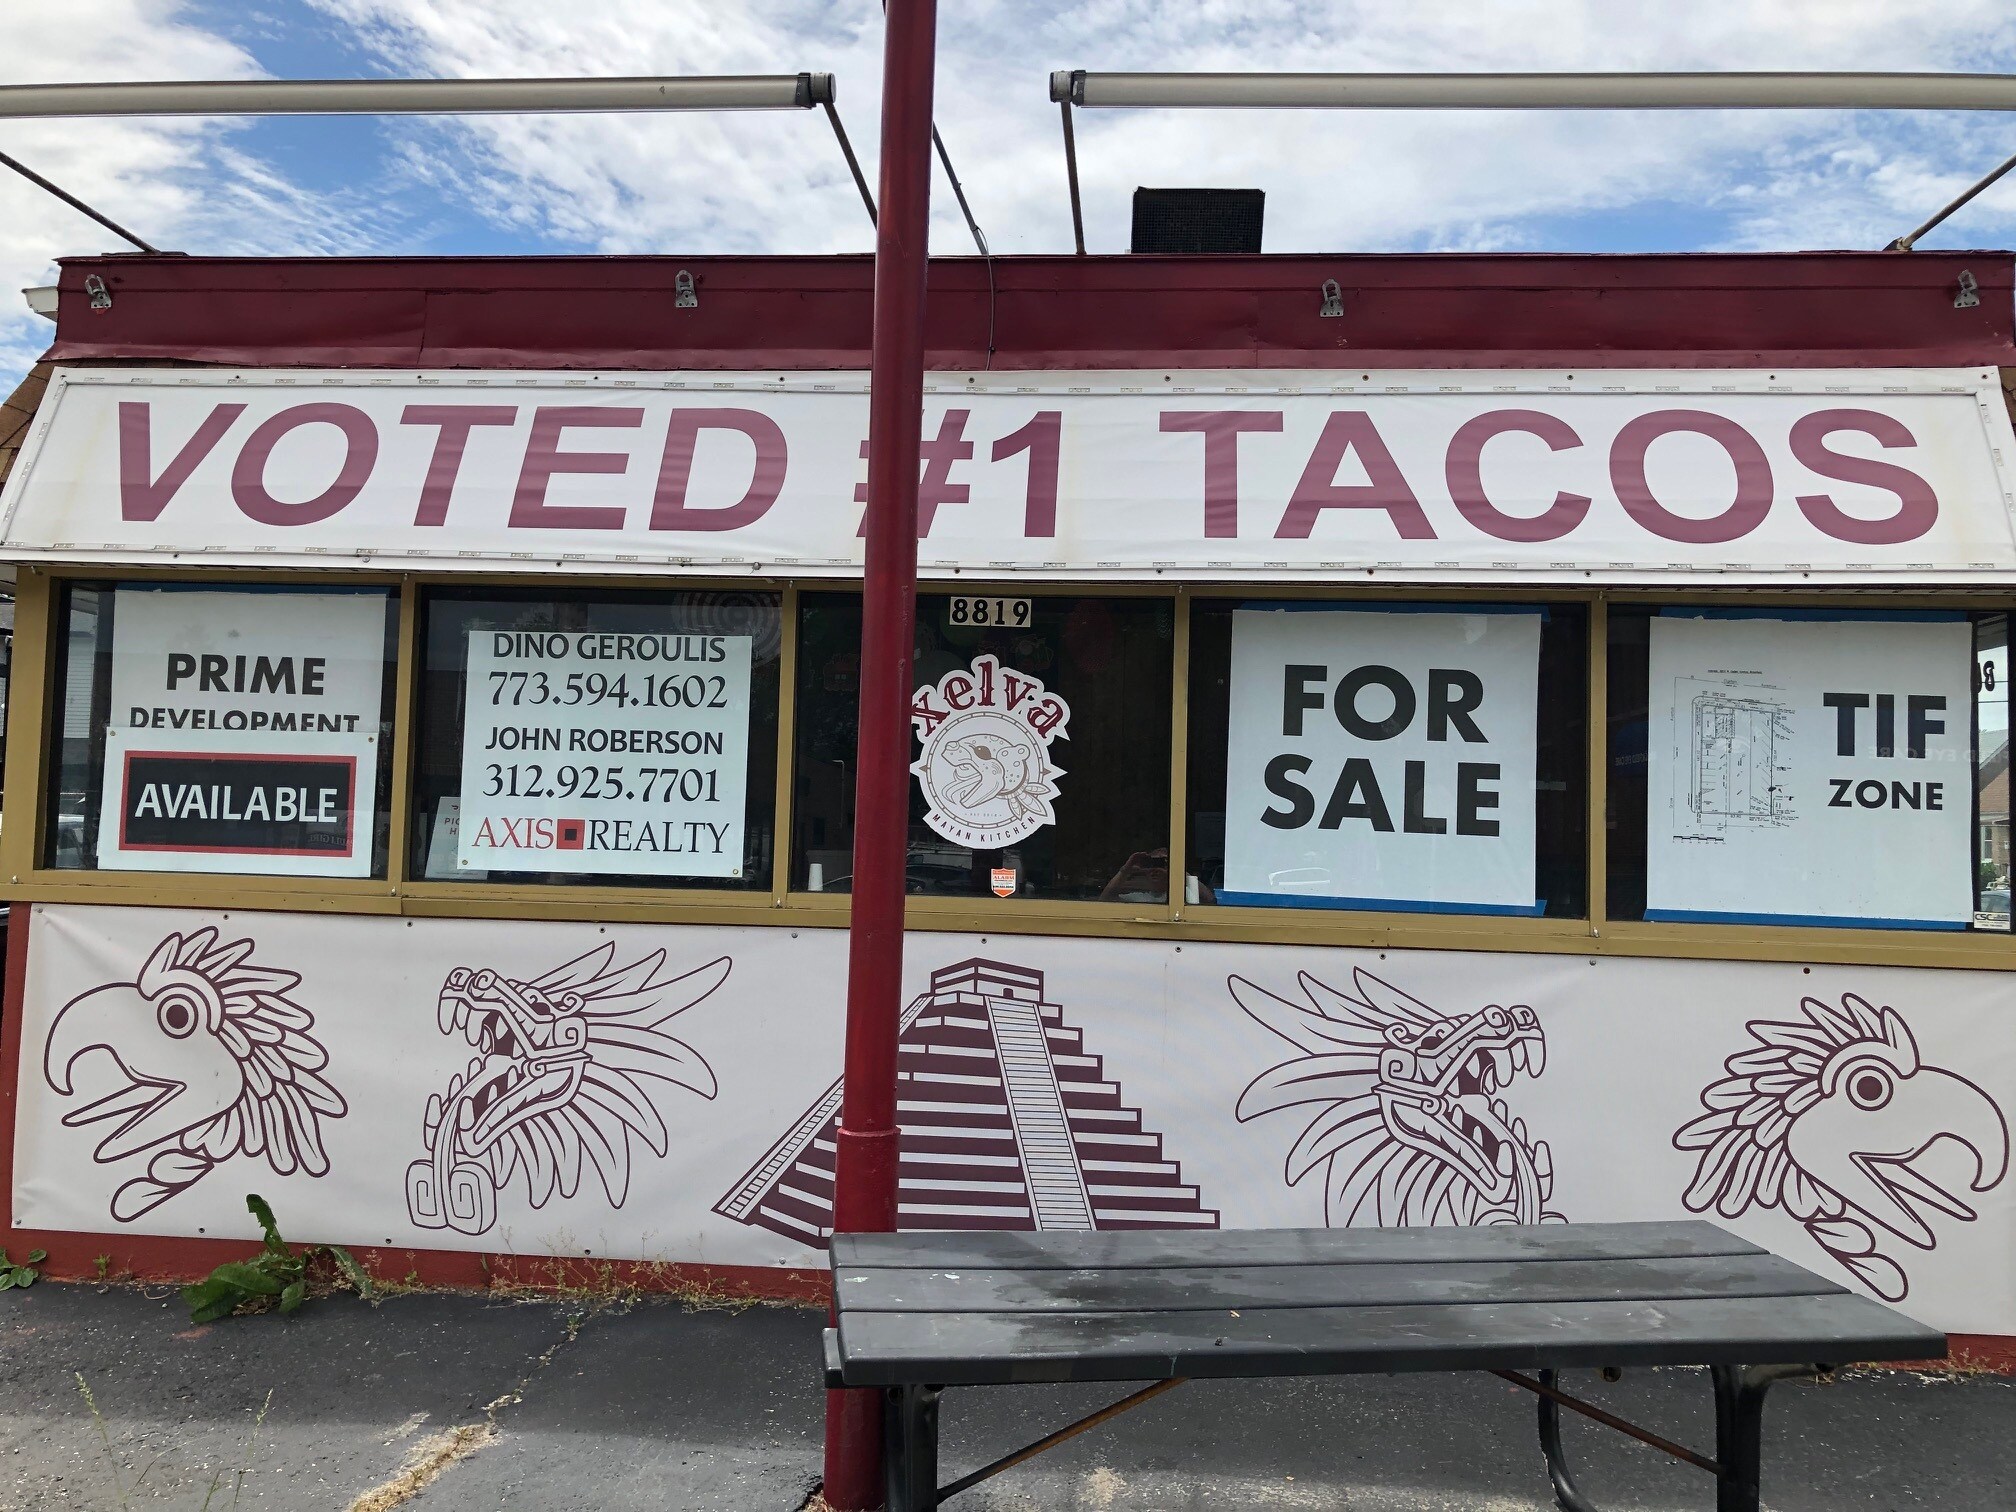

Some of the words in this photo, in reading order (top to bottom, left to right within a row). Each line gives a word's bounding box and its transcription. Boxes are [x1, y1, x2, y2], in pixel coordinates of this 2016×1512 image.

[118, 402, 788, 531] VOTED
[854, 409, 1063, 538] #1
[1159, 409, 1938, 545] TACOS
[950, 599, 1029, 626] 8819
[494, 632, 570, 659] DINO
[577, 634, 726, 663] GEROULIS
[166, 652, 326, 696] PRIME
[488, 671, 728, 708] 773.594.1602
[130, 706, 360, 733] DEVELOPMENT
[911, 661, 1064, 739] xelva
[1283, 664, 1490, 744] FOR
[485, 726, 561, 751] JOHN
[569, 728, 723, 755] ROBERSON
[1823, 692, 1947, 760] TIF
[482, 763, 720, 803] 312.925.7701
[1260, 753, 1501, 837] SALE
[1827, 778, 1944, 811] ZONE
[134, 783, 338, 824] AVAILABLE
[472, 816, 555, 850] AXIS
[588, 820, 730, 854] REALTY
[932, 813, 971, 841] MAYAN
[980, 817, 1036, 843] KITCHEN
